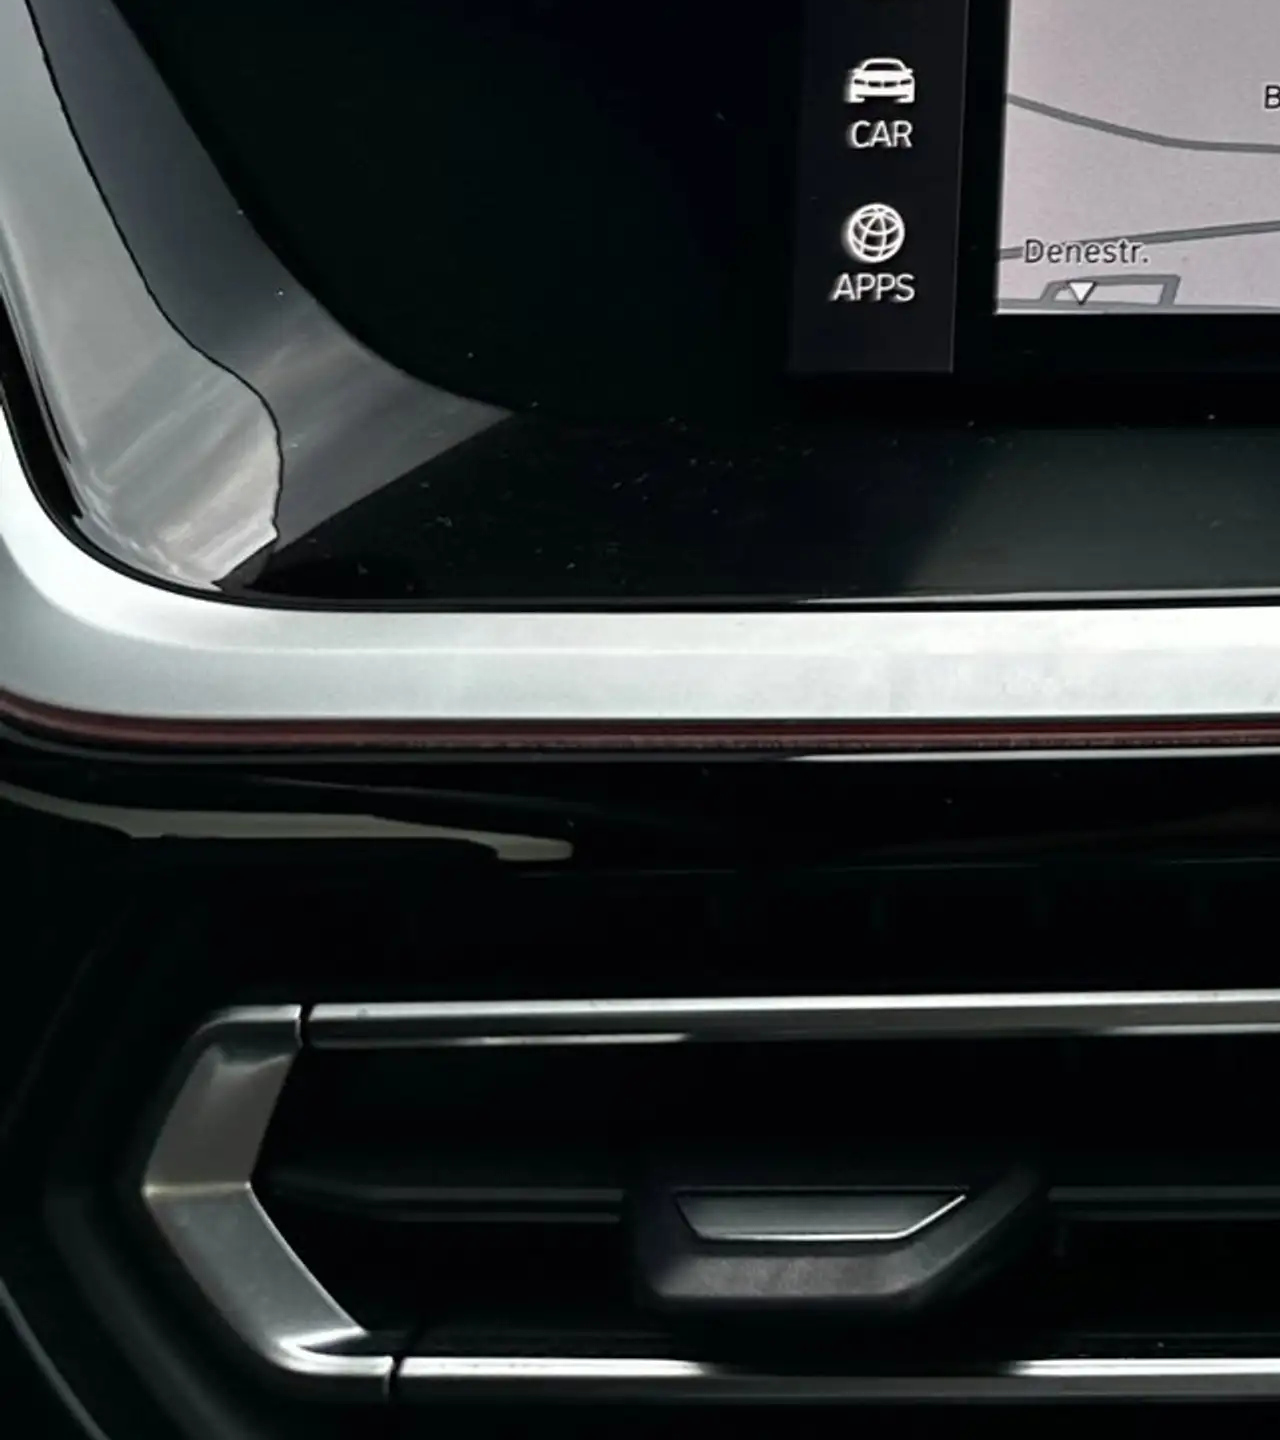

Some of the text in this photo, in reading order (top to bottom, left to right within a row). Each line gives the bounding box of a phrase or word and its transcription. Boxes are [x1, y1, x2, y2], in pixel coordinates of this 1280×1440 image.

[850, 120, 913, 148] CAR
[1024, 240, 1148, 265] Denestr.
[830, 273, 916, 302] APPS
